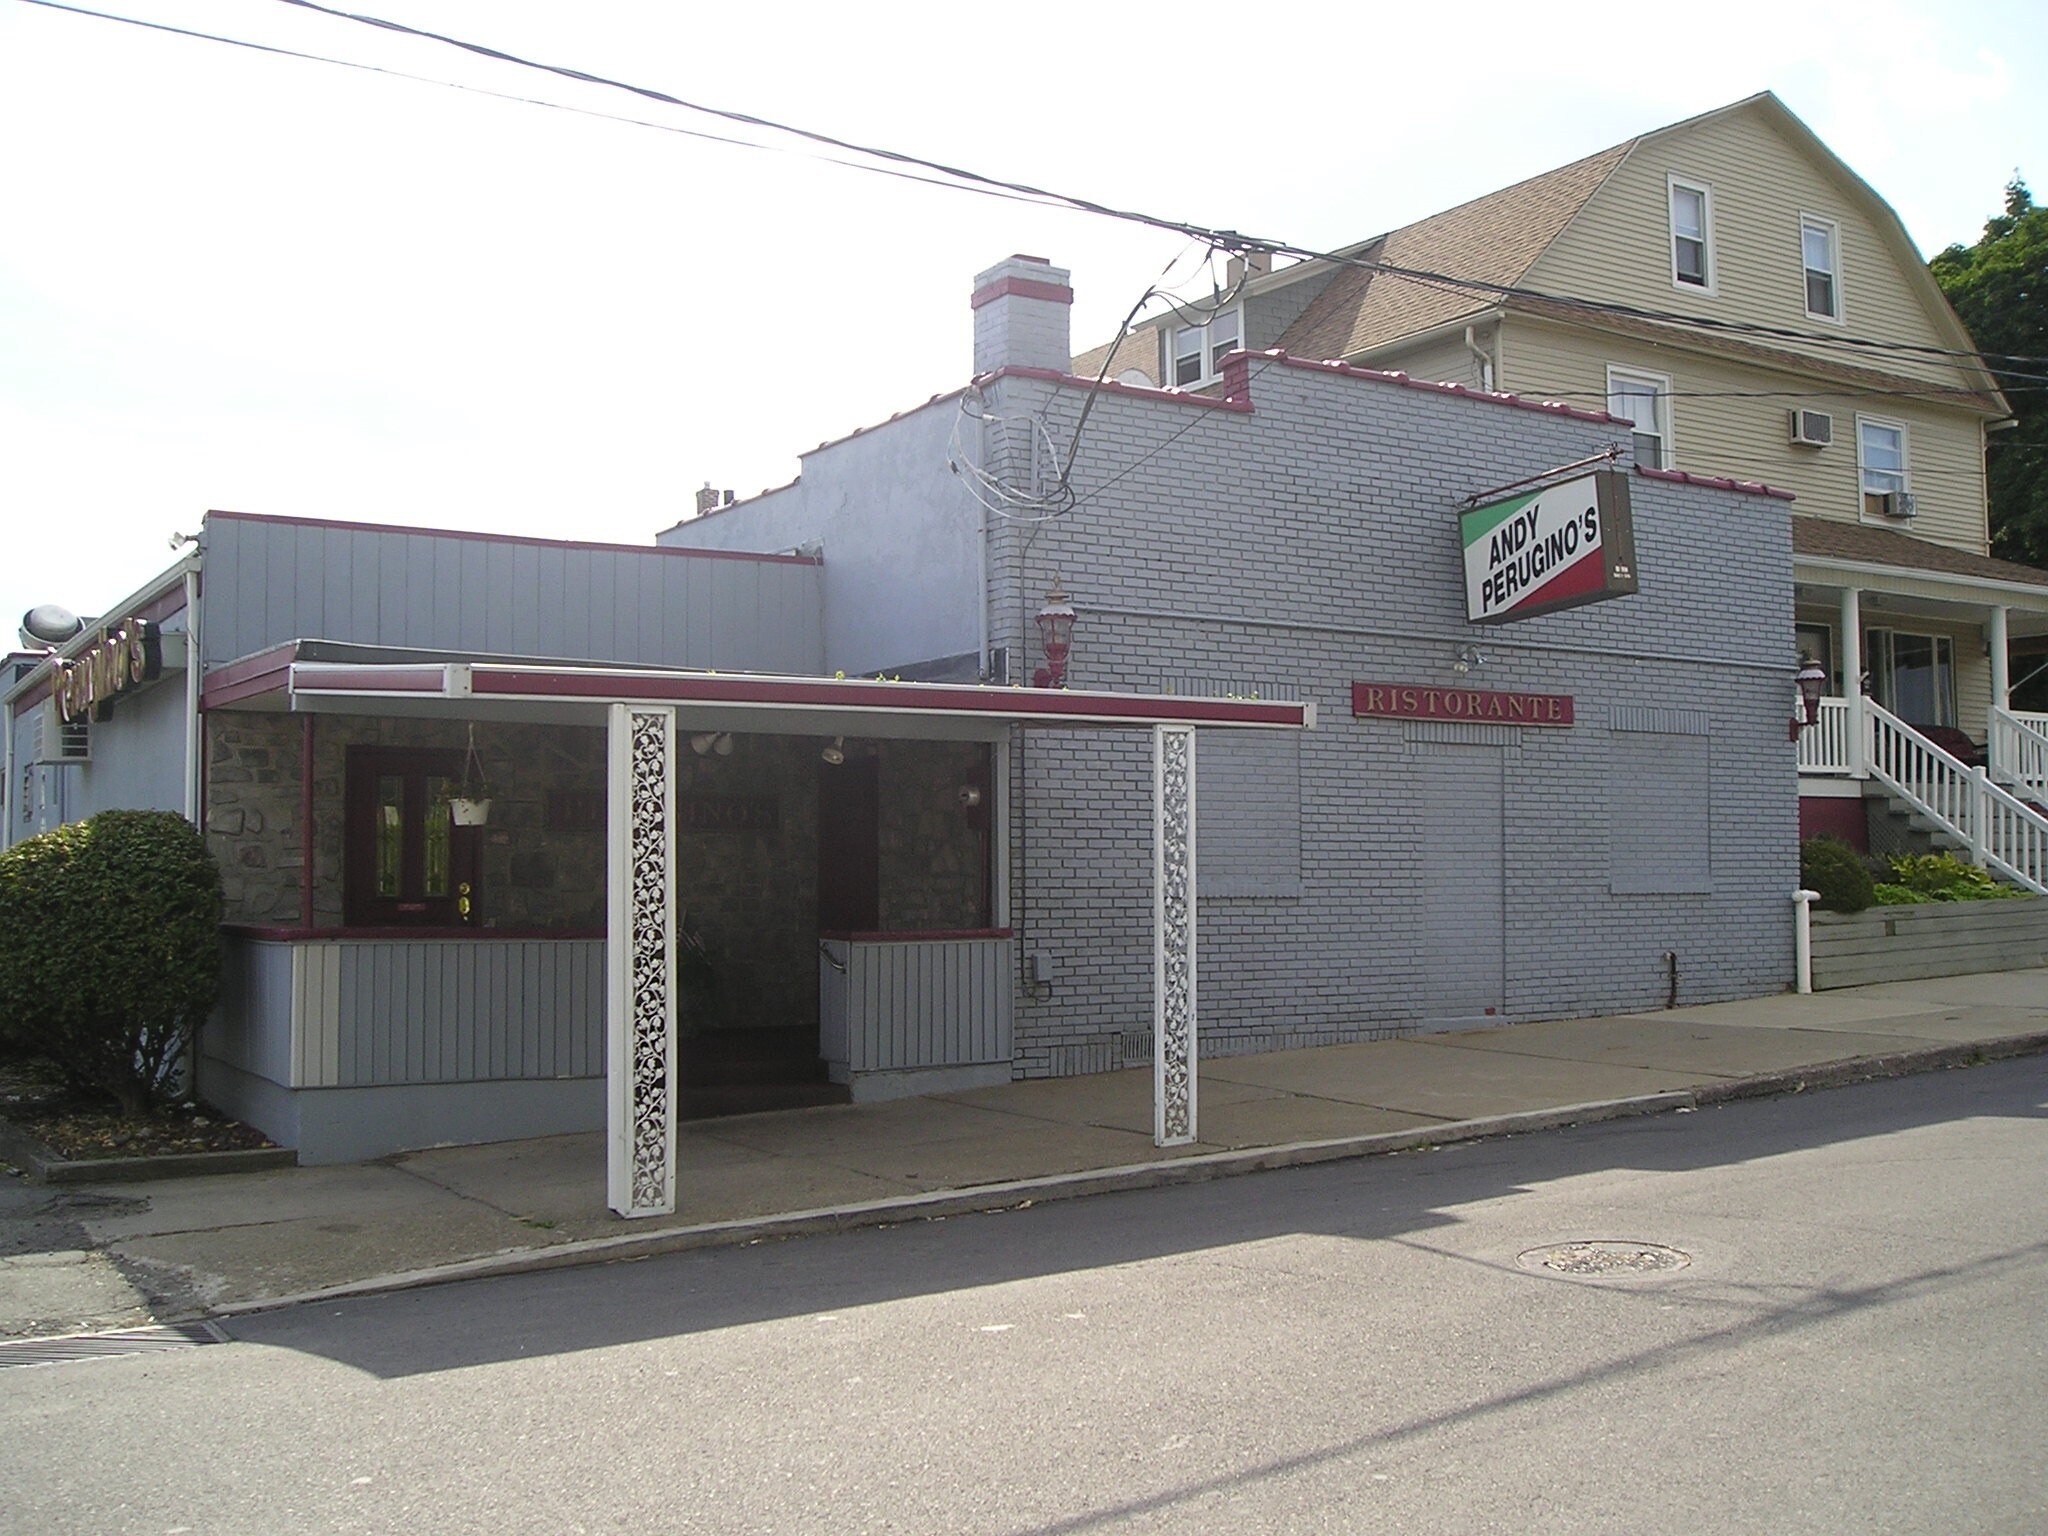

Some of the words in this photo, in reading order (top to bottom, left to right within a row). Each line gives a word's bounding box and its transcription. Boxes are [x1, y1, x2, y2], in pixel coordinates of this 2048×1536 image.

[1482, 506, 1597, 614] PERUGINO'S
[1489, 504, 1540, 571] ANDY
[1367, 688, 1561, 720] RISTORANTE
